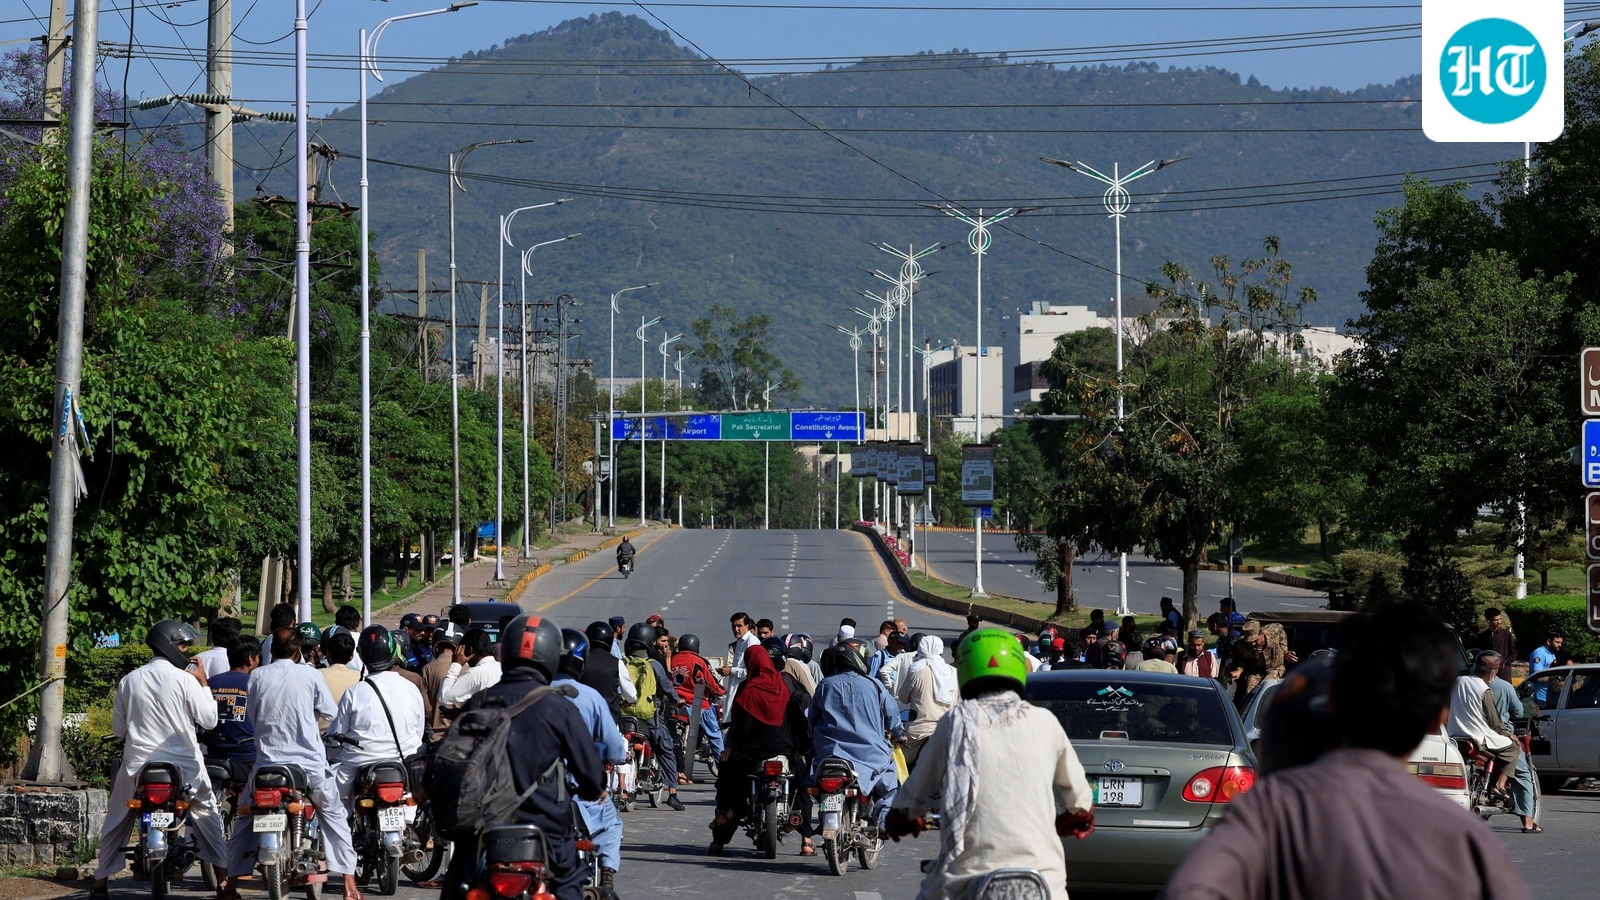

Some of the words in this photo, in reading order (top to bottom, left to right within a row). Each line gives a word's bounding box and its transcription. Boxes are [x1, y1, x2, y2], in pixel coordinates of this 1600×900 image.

[681, 428, 707, 436] Airport
[1103, 778, 1125, 790] LRN
[1103, 792, 1124, 803] 198
[384, 808, 399, 817] AKR
[384, 817, 400, 826] 365
